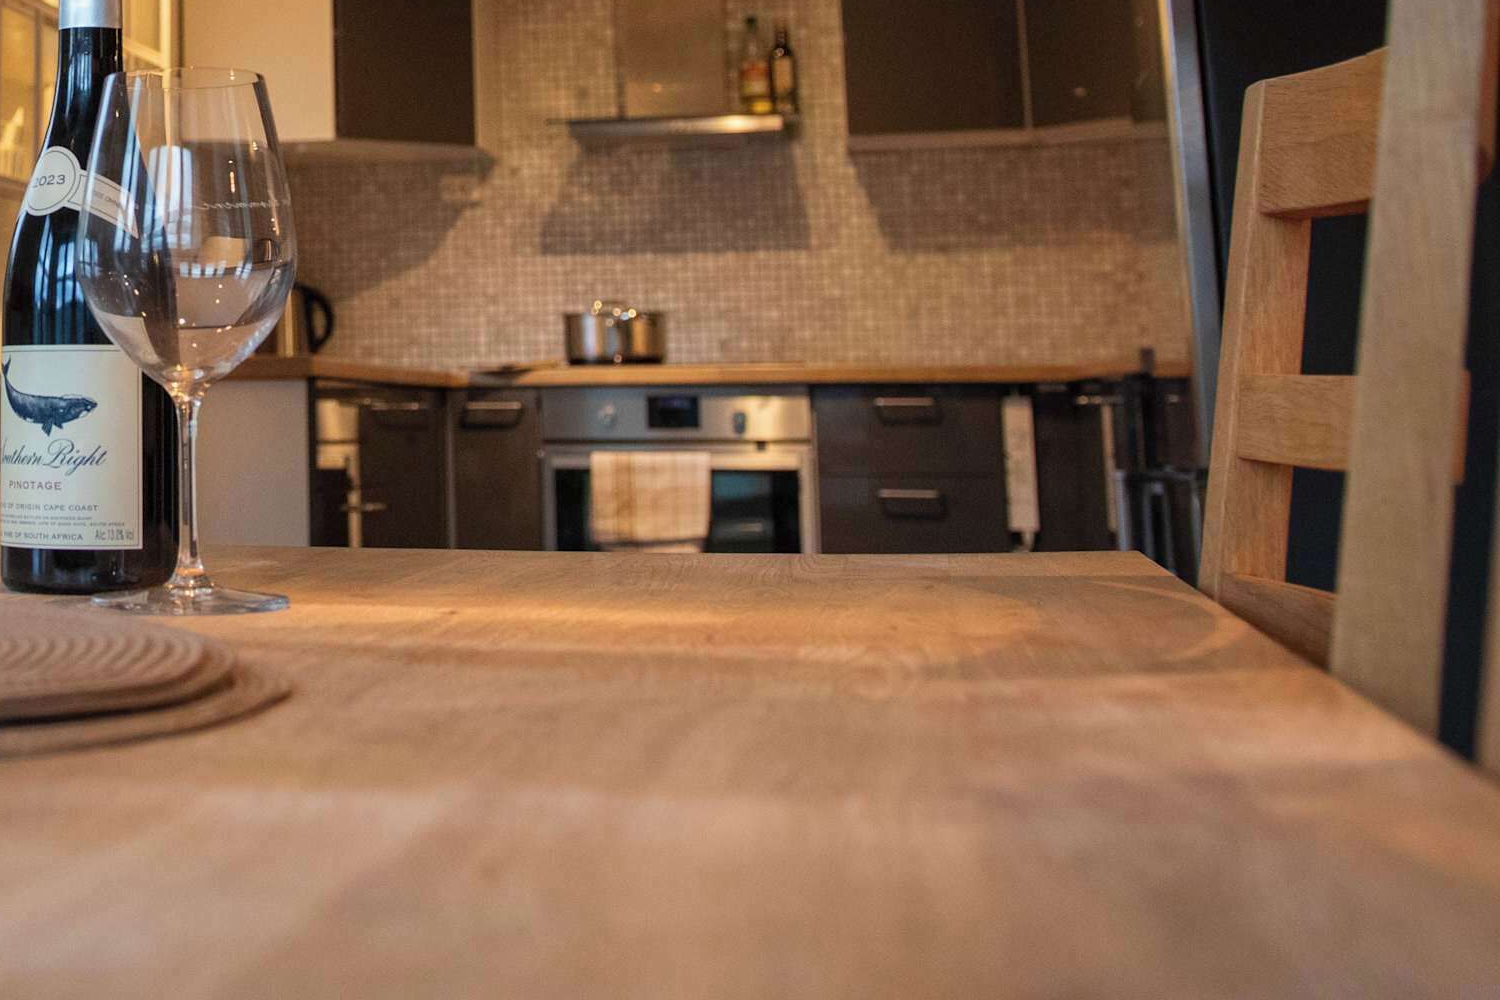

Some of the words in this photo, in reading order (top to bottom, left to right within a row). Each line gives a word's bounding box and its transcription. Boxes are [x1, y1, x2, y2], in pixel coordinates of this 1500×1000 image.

[31, 174, 66, 188] 2023
[42, 438, 108, 476] Right
[8, 481, 62, 491] PINOTAGE
[43, 504, 66, 512] CAPE
[68, 504, 100, 512] COAST
[24, 532, 49, 540] SOUTH
[51, 533, 84, 541] AFRICA
